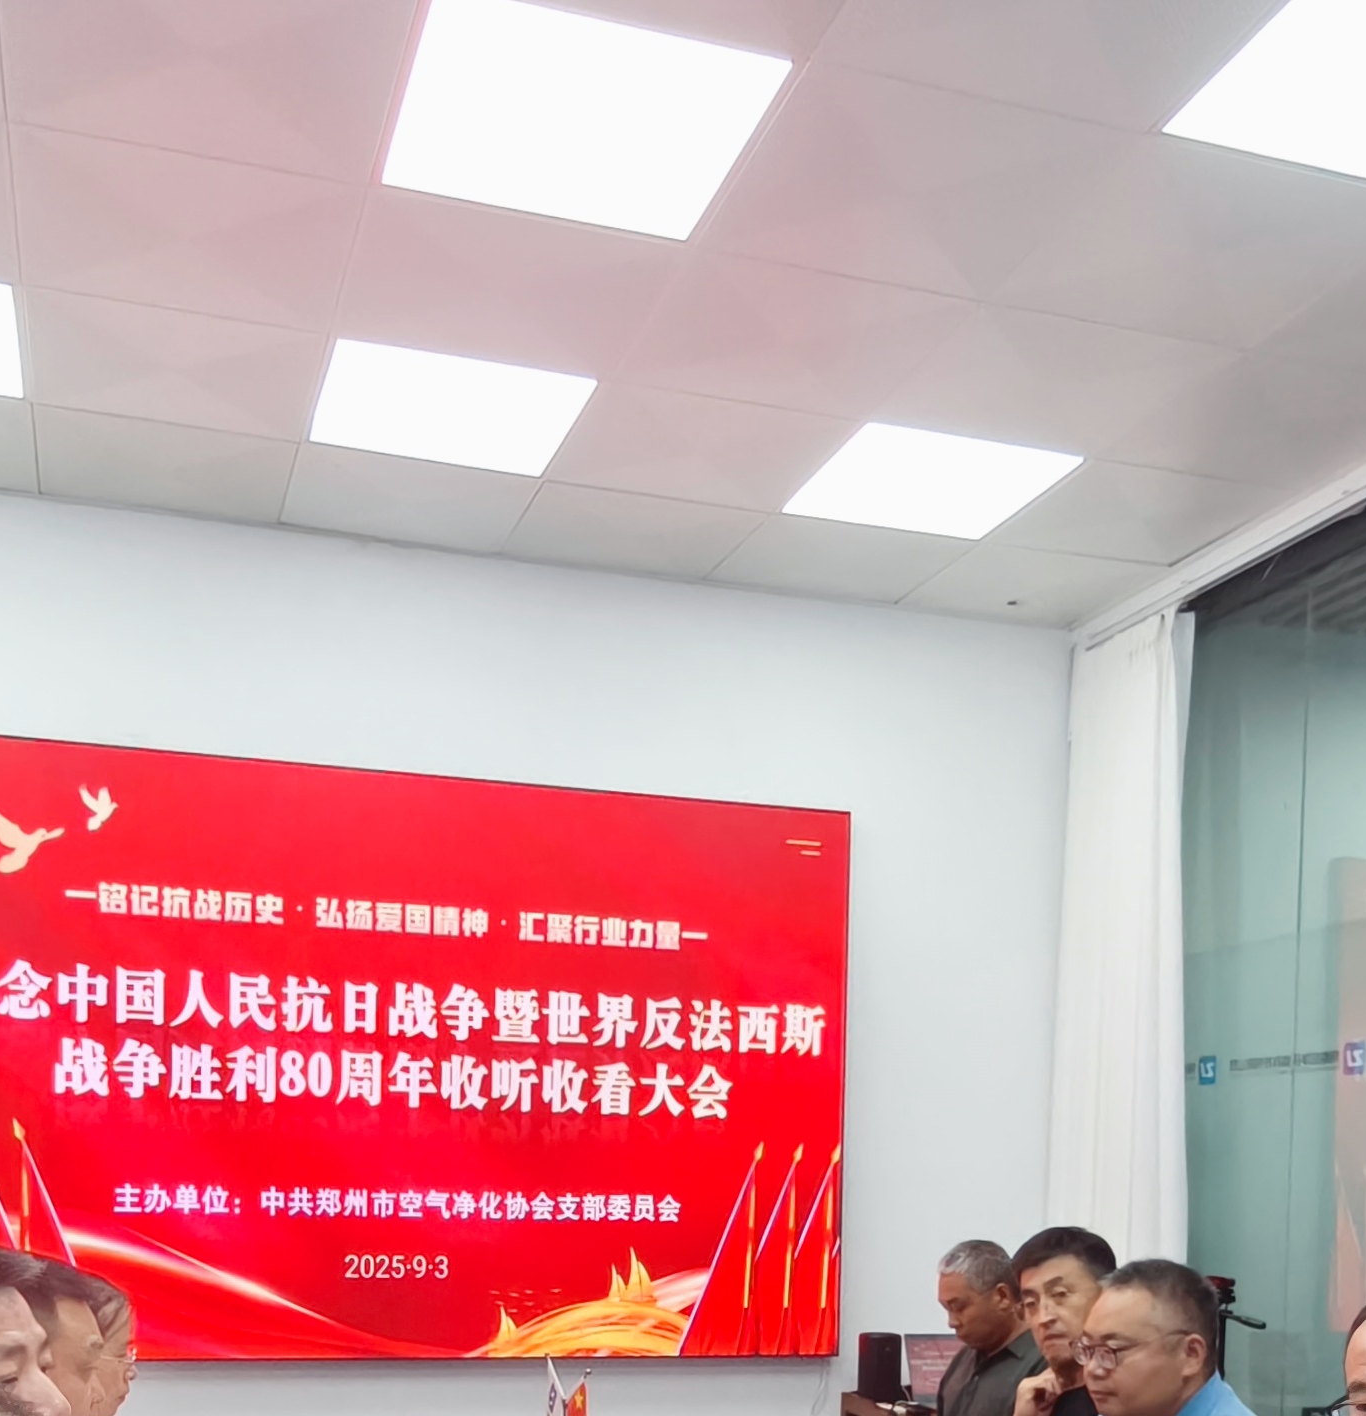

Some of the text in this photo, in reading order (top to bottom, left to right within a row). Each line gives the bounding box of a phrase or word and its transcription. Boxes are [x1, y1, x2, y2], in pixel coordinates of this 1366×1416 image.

[53, 1036, 733, 1120] 战争胜利80周年收听收看大会
